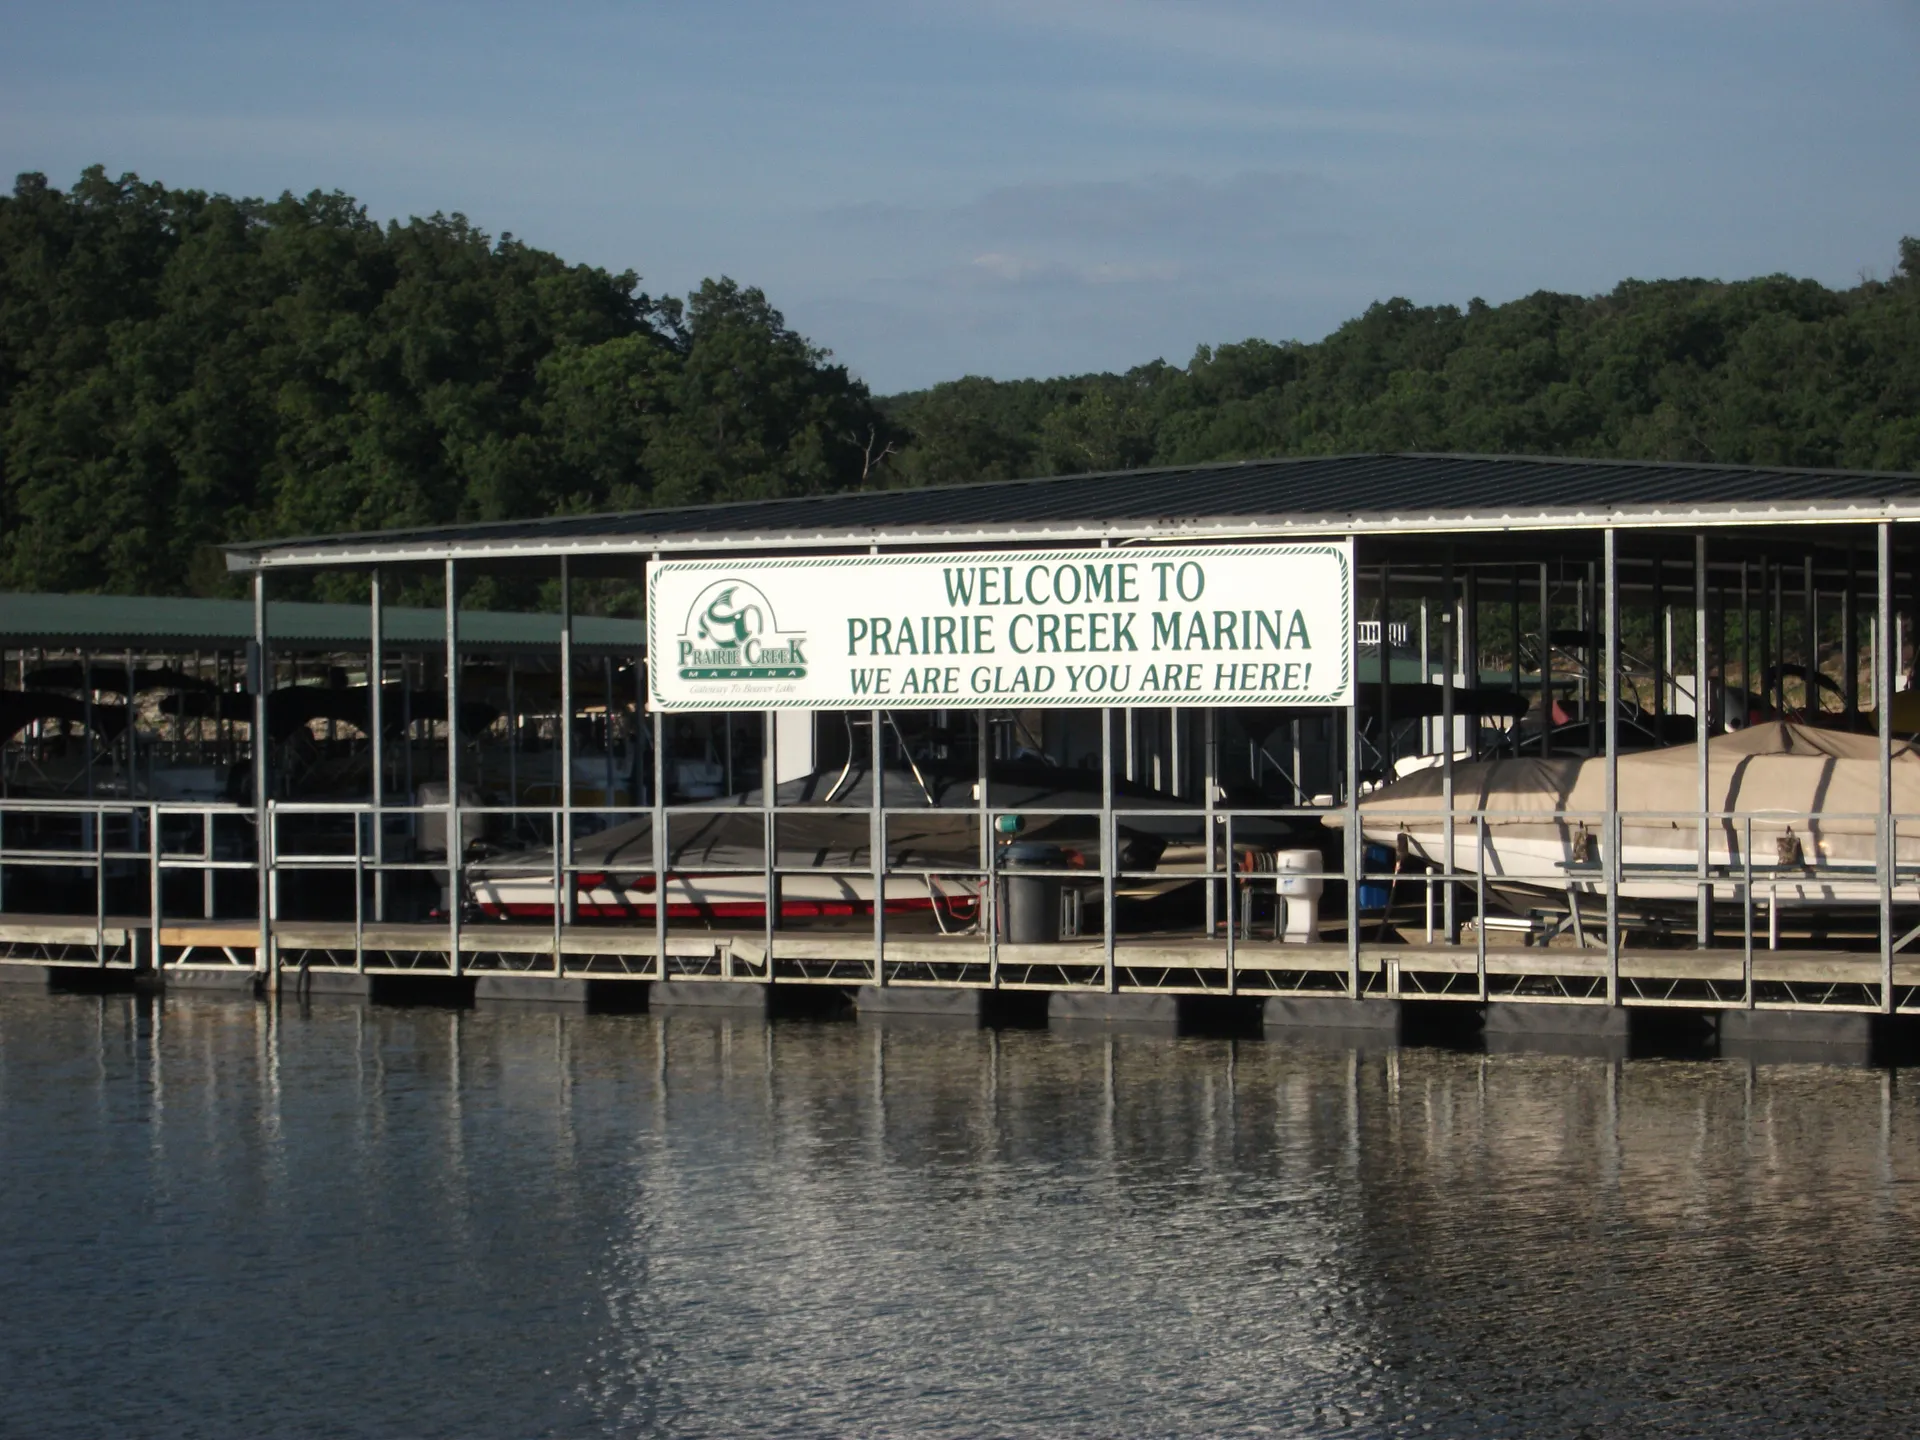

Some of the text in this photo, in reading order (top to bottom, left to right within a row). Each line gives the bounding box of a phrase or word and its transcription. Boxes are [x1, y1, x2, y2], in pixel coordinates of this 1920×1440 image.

[943, 561, 1206, 606] WELCOME TO
[847, 608, 1312, 656] PRAIRIE CREEK MARINA
[677, 638, 808, 666] PRAIRIE CREEK
[730, 684, 742, 693] To
[849, 662, 1312, 695] WE ARE GLAD YOU ARE HERE!
